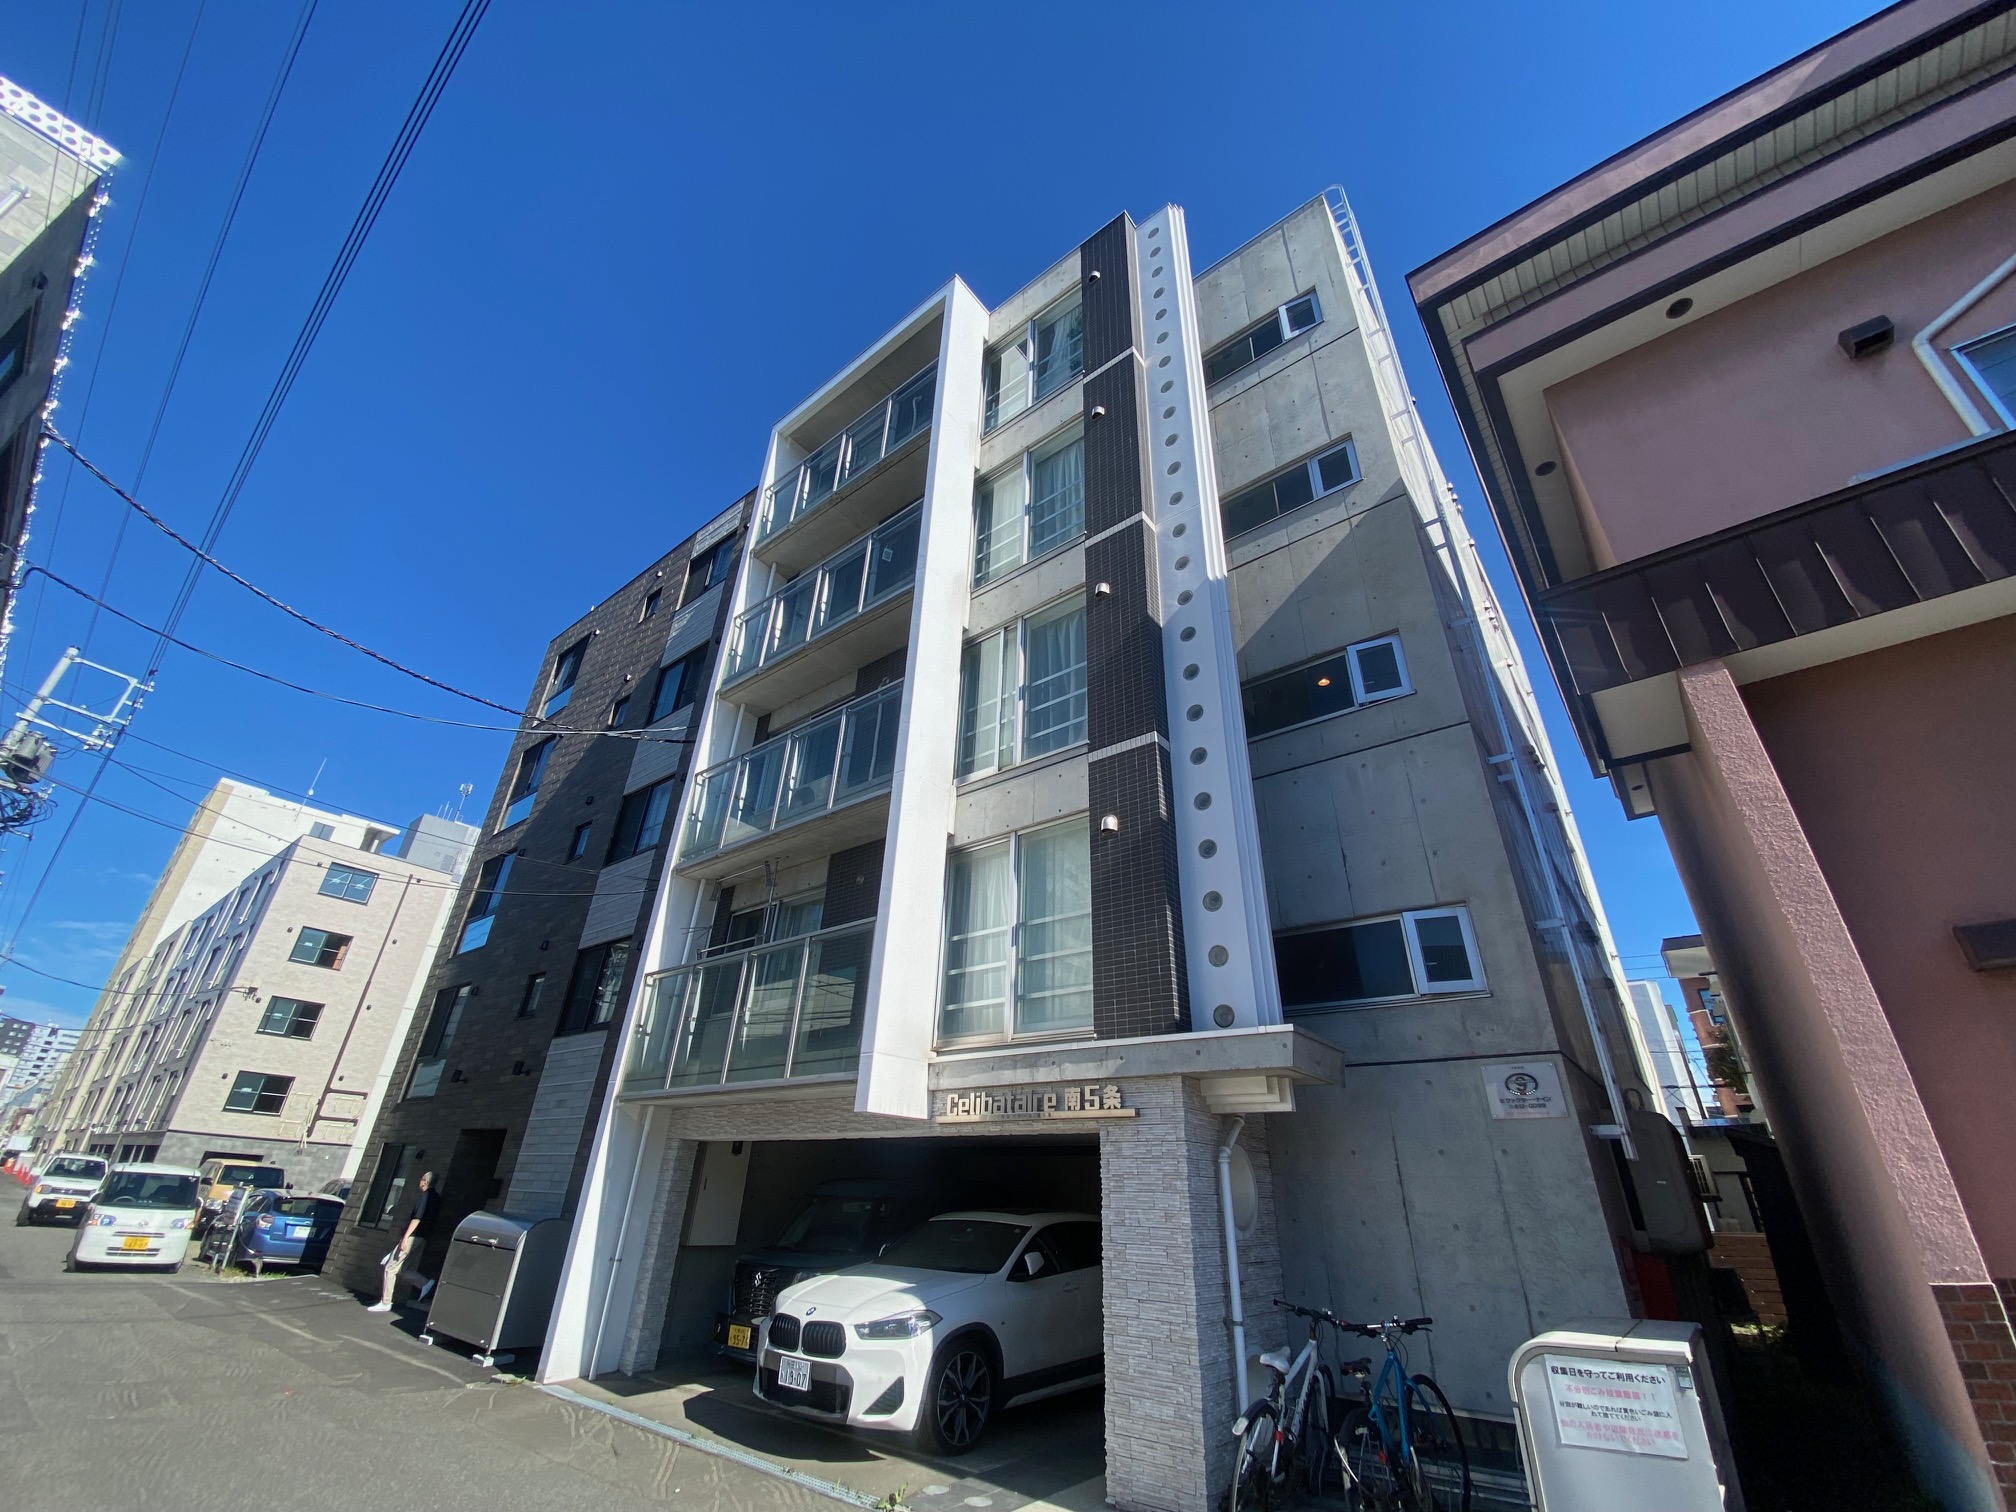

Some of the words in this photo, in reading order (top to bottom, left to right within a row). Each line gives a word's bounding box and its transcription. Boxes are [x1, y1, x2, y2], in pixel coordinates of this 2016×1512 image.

[1064, 1084, 1122, 1112] 南5条
[1550, 1365, 1666, 1384] 収集日を守ってご利用ください
